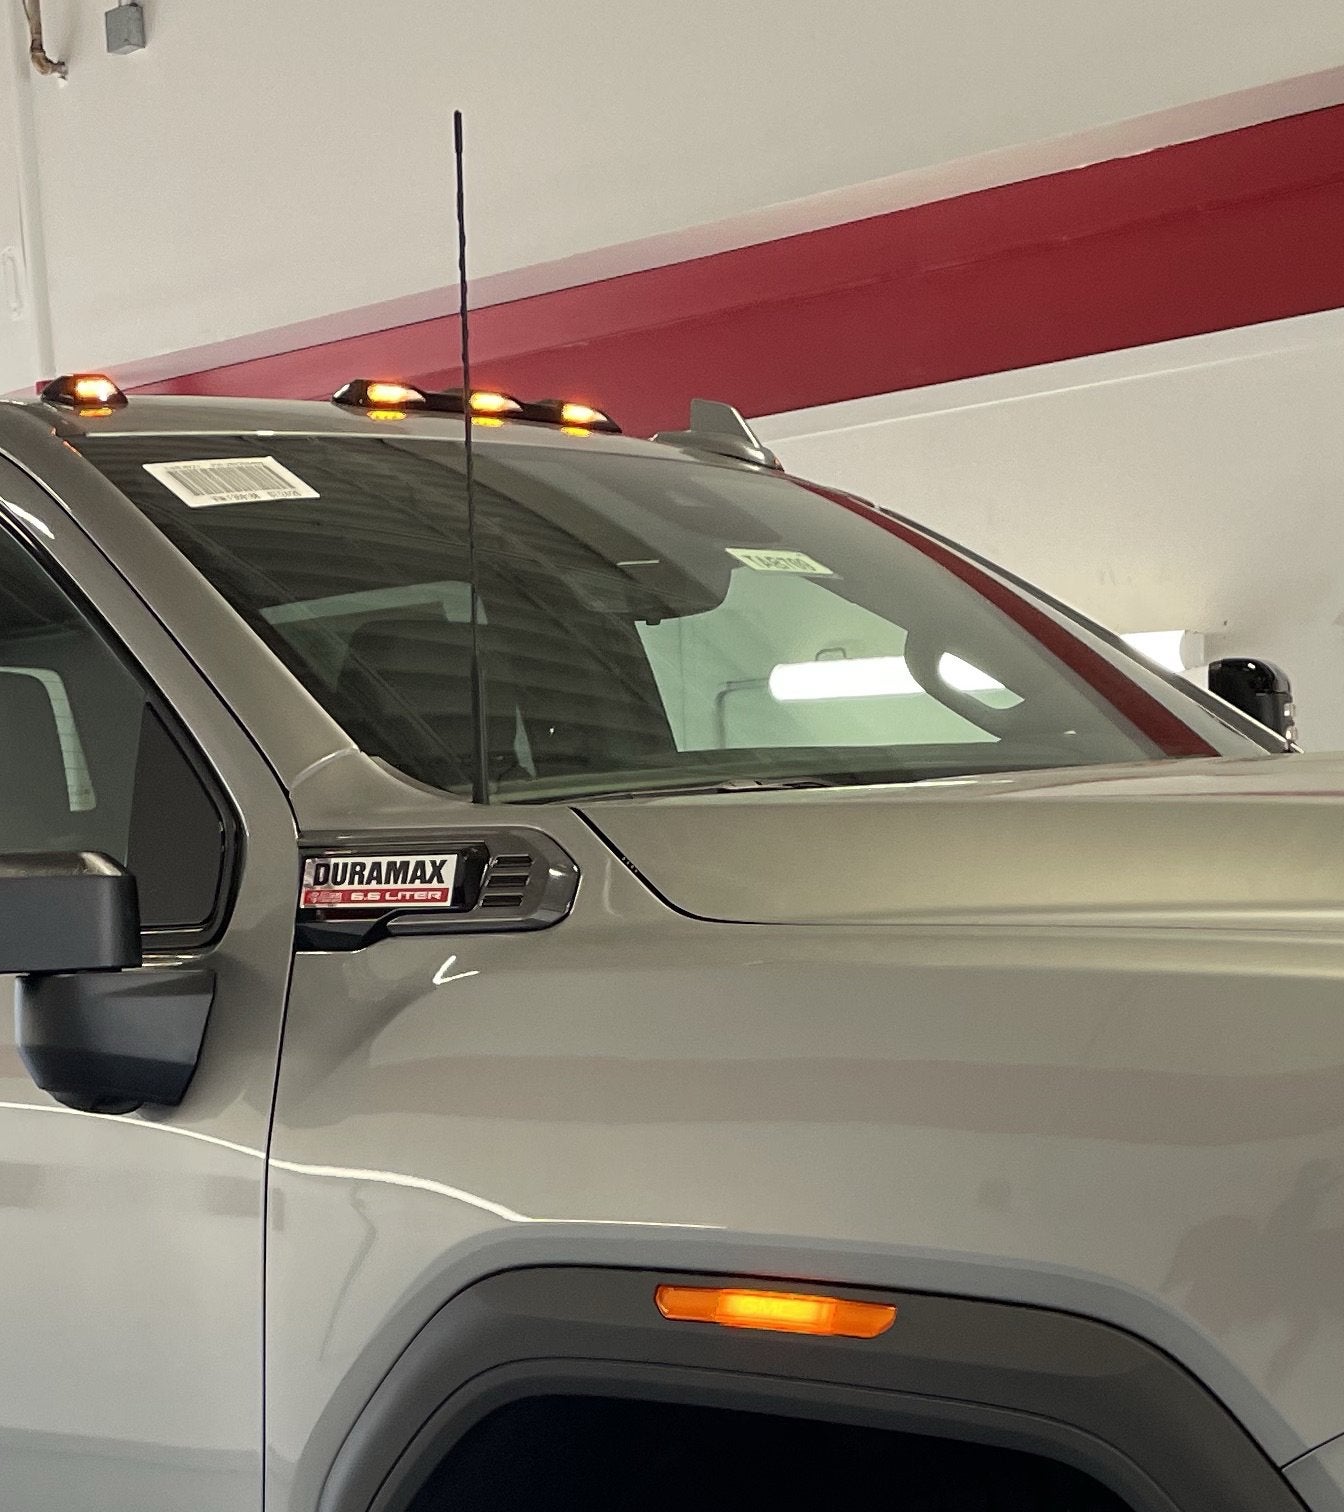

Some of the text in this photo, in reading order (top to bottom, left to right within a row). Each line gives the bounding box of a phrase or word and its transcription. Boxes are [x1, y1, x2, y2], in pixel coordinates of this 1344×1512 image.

[312, 858, 448, 886] DURAMAX
[350, 891, 381, 901] 6.6
[384, 890, 442, 901] LITER
